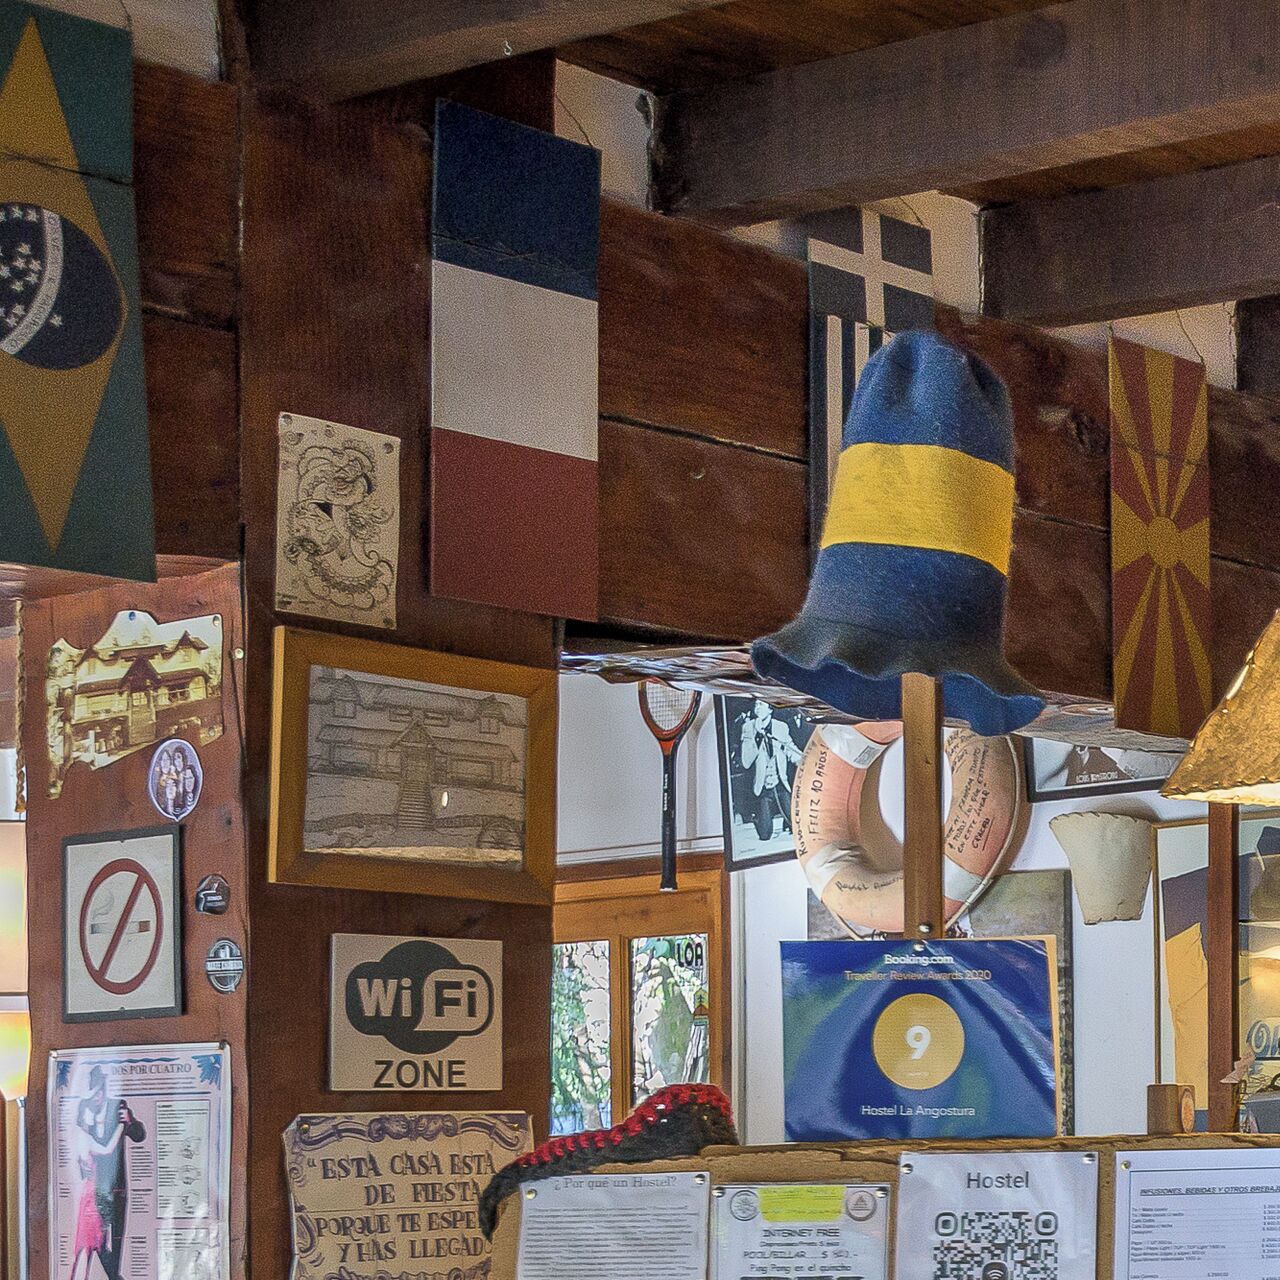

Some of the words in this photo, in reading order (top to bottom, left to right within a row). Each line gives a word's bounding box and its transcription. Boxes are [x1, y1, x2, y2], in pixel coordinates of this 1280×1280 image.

[811, 780, 823, 795] 10
[885, 954, 954, 966] Booking.com
[845, 971, 887, 980] Traveller
[890, 971, 925, 980] Review
[928, 971, 963, 980] Awards
[906, 1025, 931, 1060] 9
[149, 1063, 192, 1074] CUATRO
[374, 1060, 466, 1088] ZONE
[861, 1105, 897, 1116] Hostel
[900, 1106, 913, 1115] La
[916, 1106, 975, 1118] Angostura
[390, 1150, 443, 1176] CASA
[966, 1171, 1029, 1190] Hostel
[364, 1184, 395, 1205] DE
[412, 1179, 481, 1203] FIESTA
[315, 1214, 390, 1240] PORQUE
[397, 1214, 420, 1232] TE
[337, 1243, 350, 1263] Y
[357, 1238, 397, 1262] HAS
